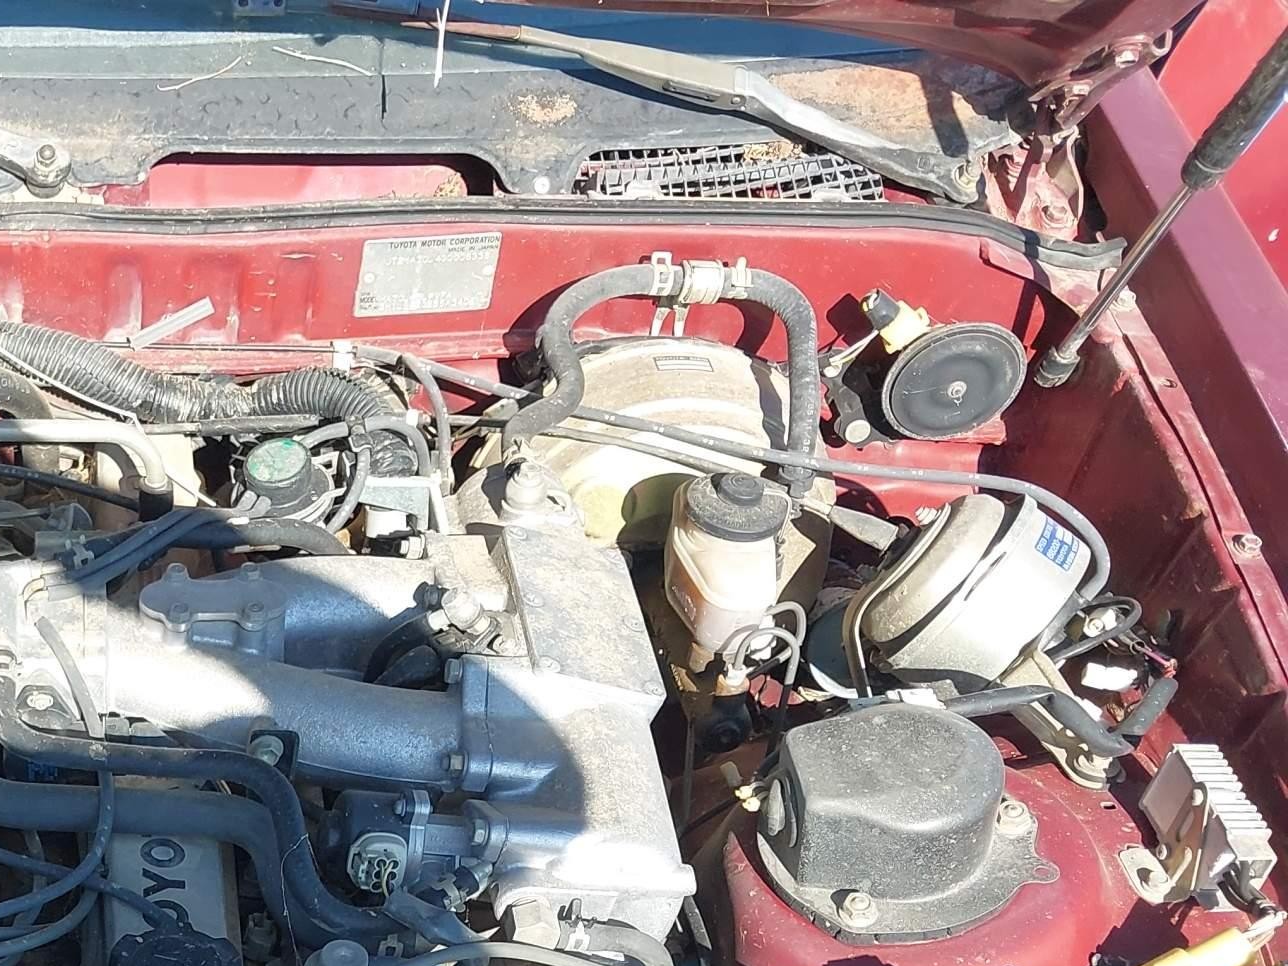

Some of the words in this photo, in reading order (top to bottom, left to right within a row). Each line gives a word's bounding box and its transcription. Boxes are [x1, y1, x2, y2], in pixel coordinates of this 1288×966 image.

[389, 240, 417, 250] TOYOTA
[420, 239, 447, 248] MOTOR
[449, 235, 500, 246] CORPORATION
